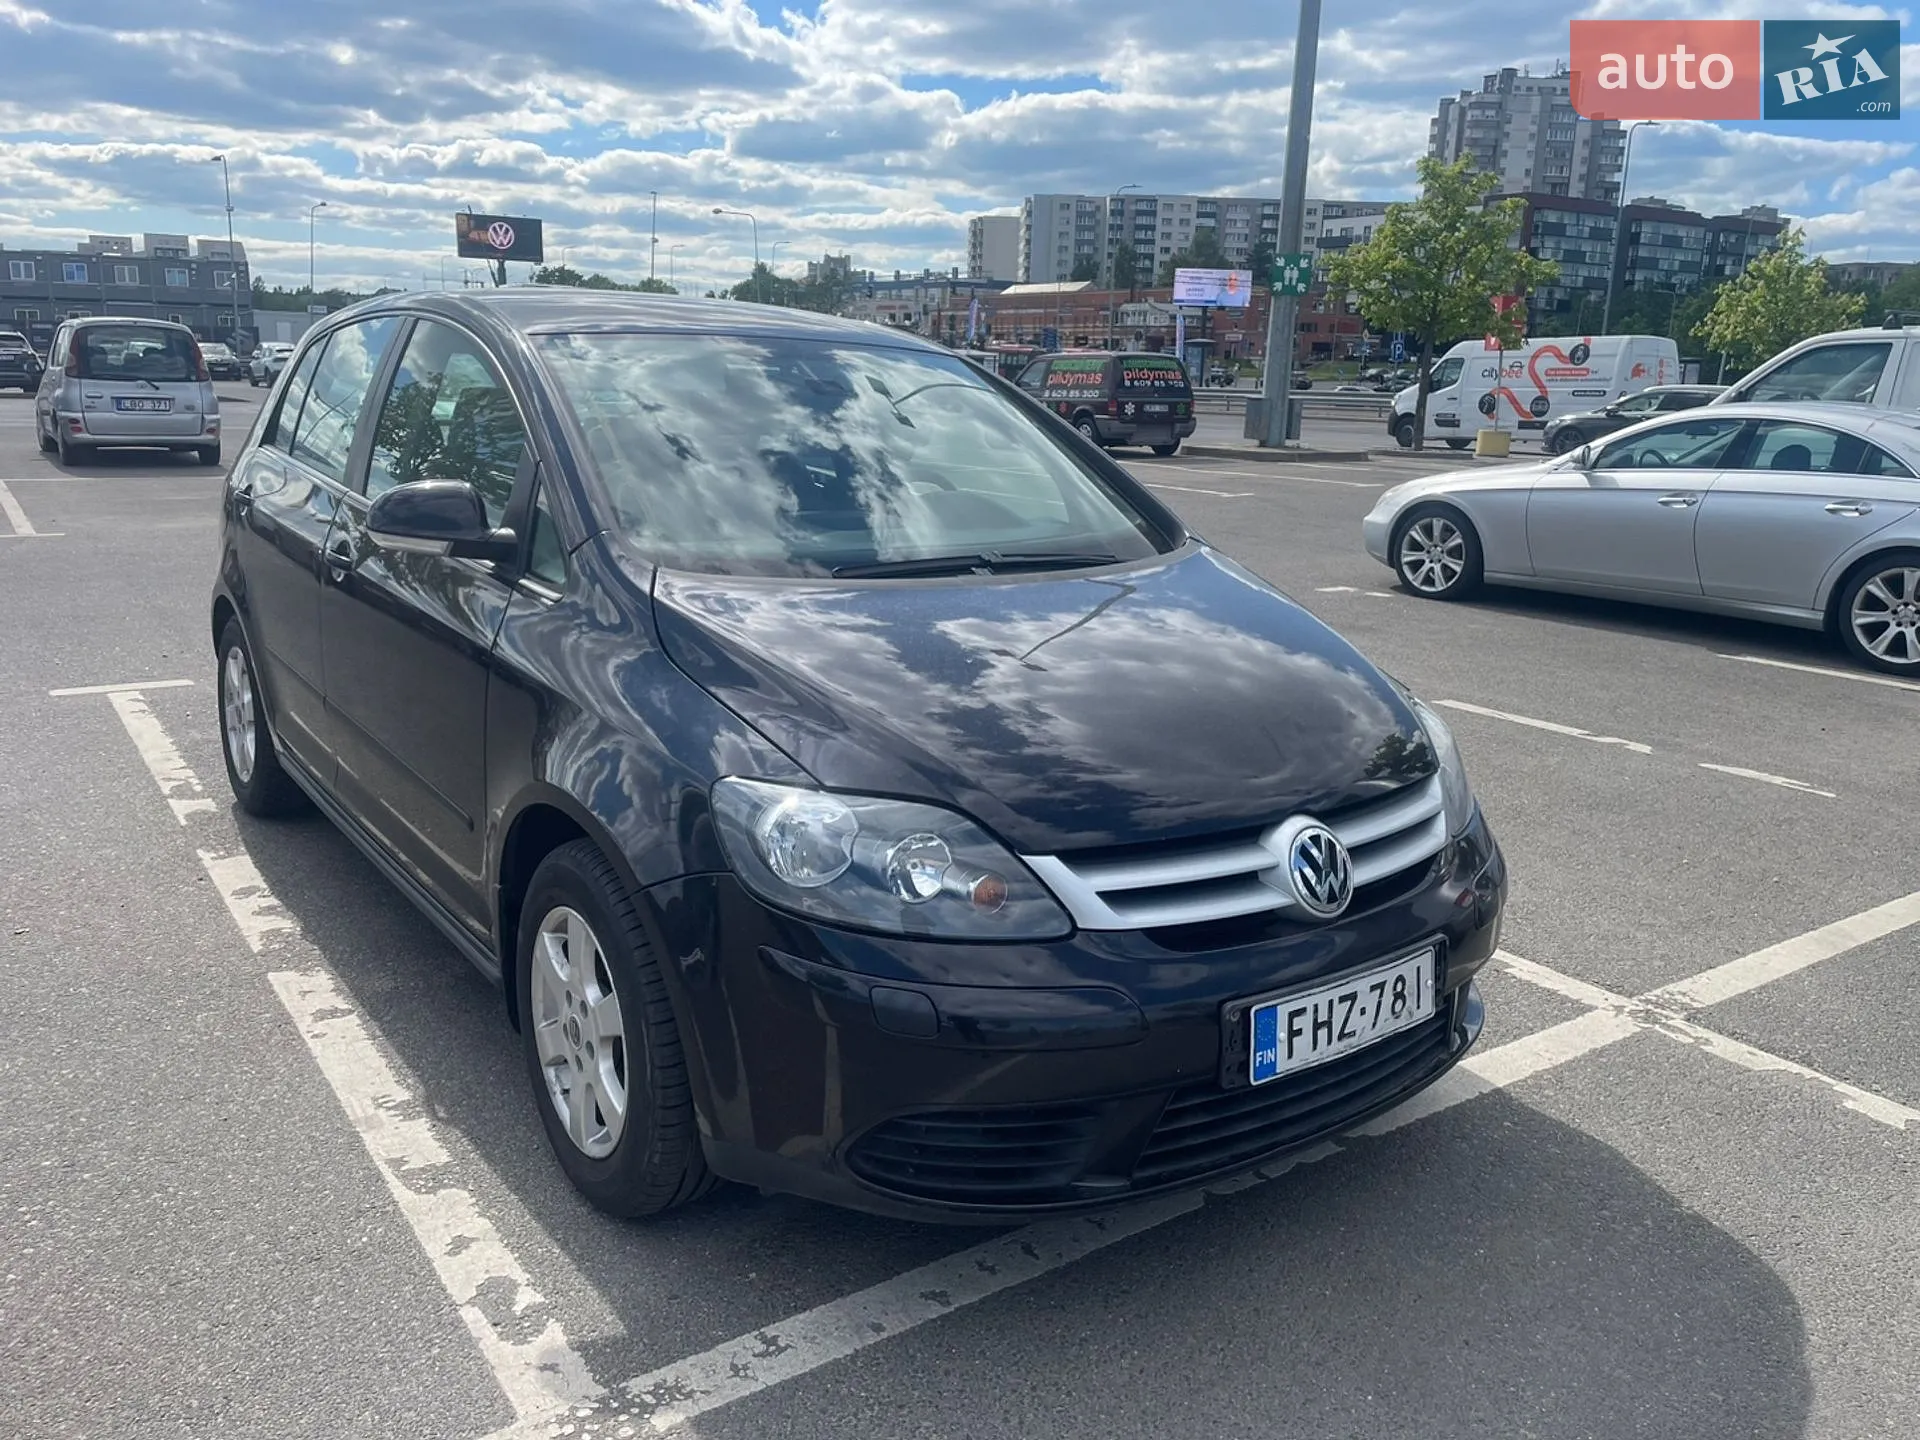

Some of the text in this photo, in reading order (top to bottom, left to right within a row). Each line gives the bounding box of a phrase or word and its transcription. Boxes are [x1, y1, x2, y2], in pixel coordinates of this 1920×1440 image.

[1047, 371, 1103, 387] pildymas
[1123, 368, 1182, 381] pildymas
[1255, 1047, 1276, 1068] FIN
